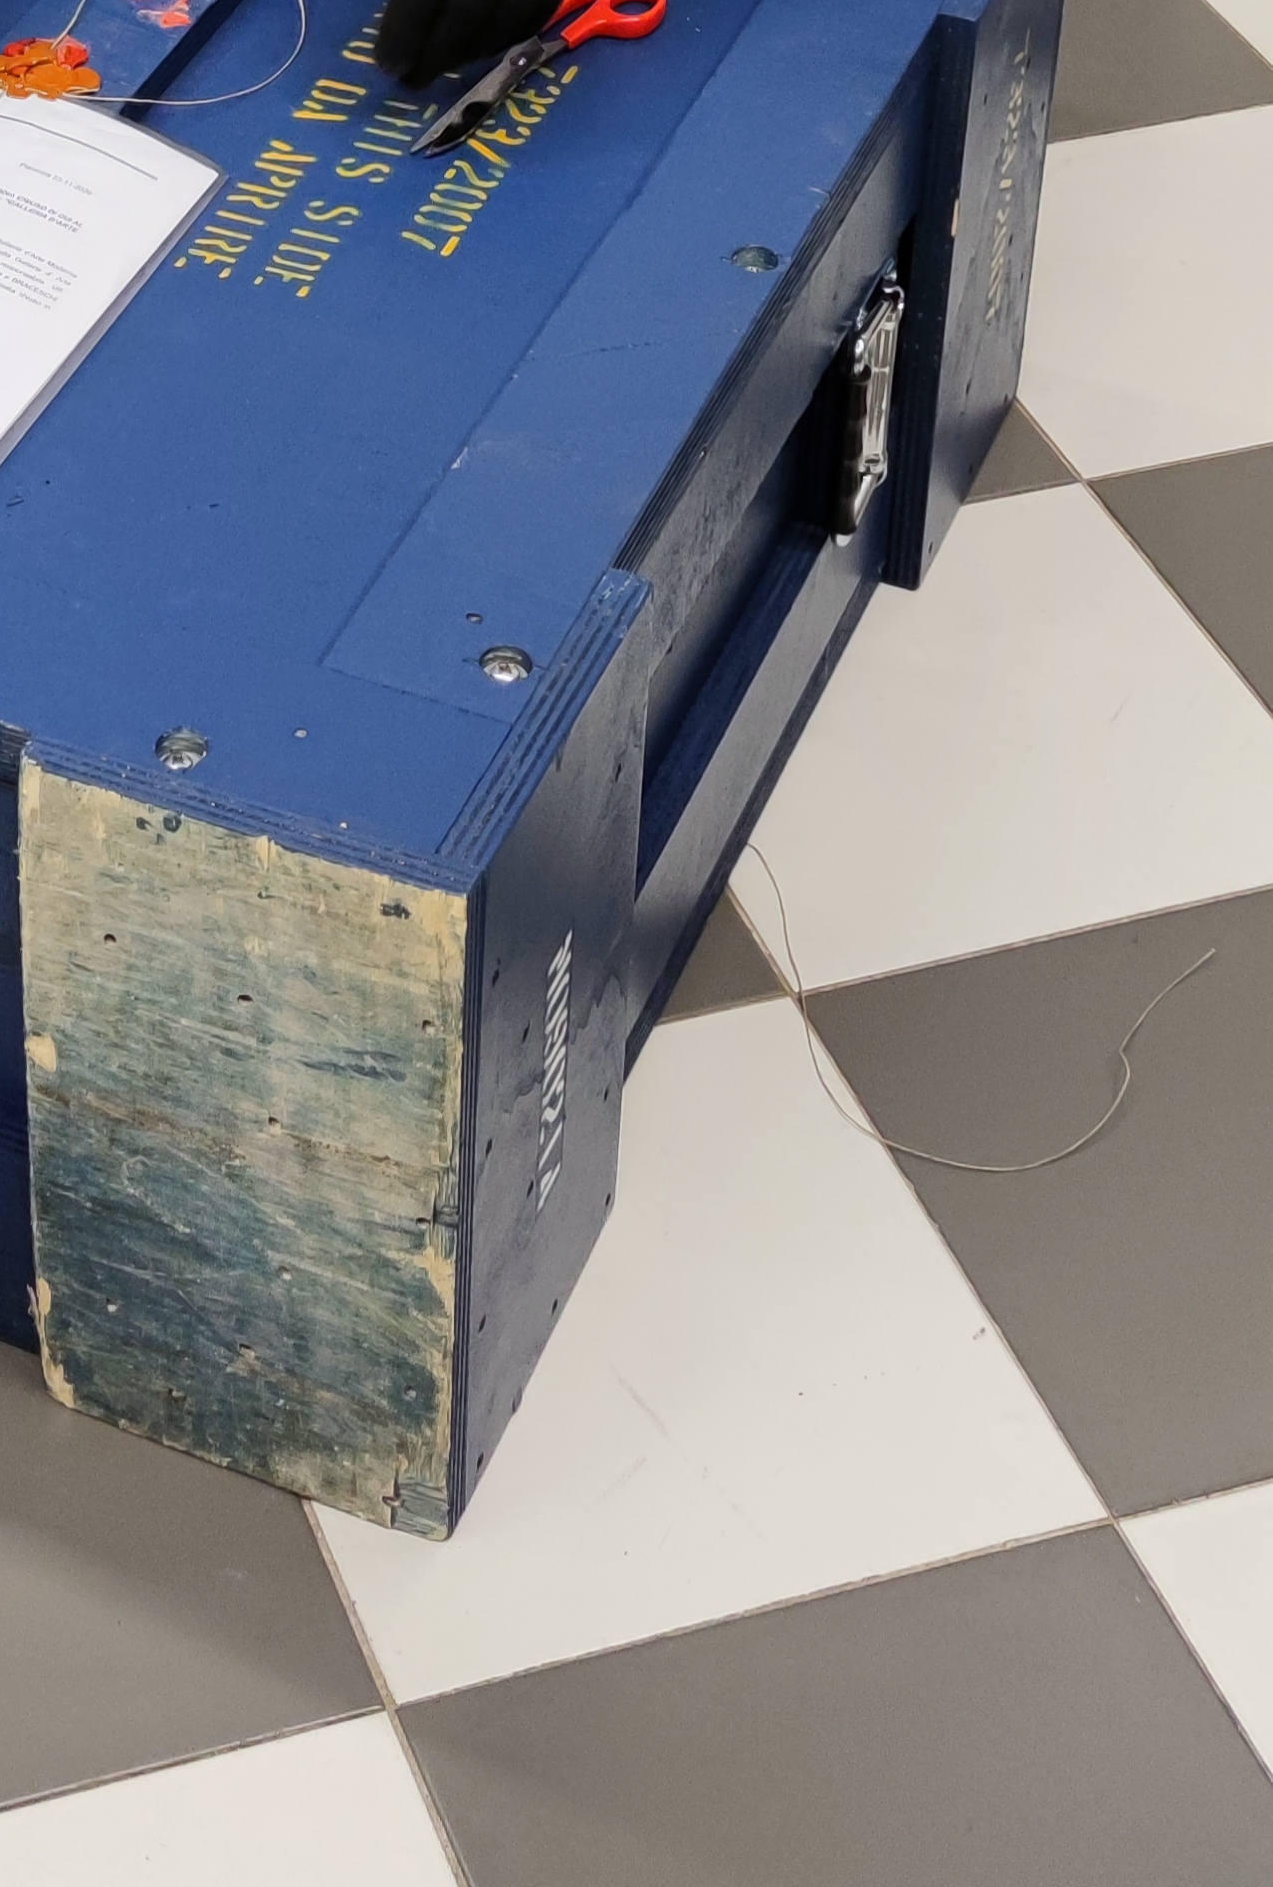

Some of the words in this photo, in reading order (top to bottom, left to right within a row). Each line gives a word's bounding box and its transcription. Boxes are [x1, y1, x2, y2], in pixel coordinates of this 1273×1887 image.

[292, 78, 367, 123] DA
[335, 99, 439, 184] THIS
[174, 139, 317, 279] APRIRE
[253, 200, 360, 298] SIDE
